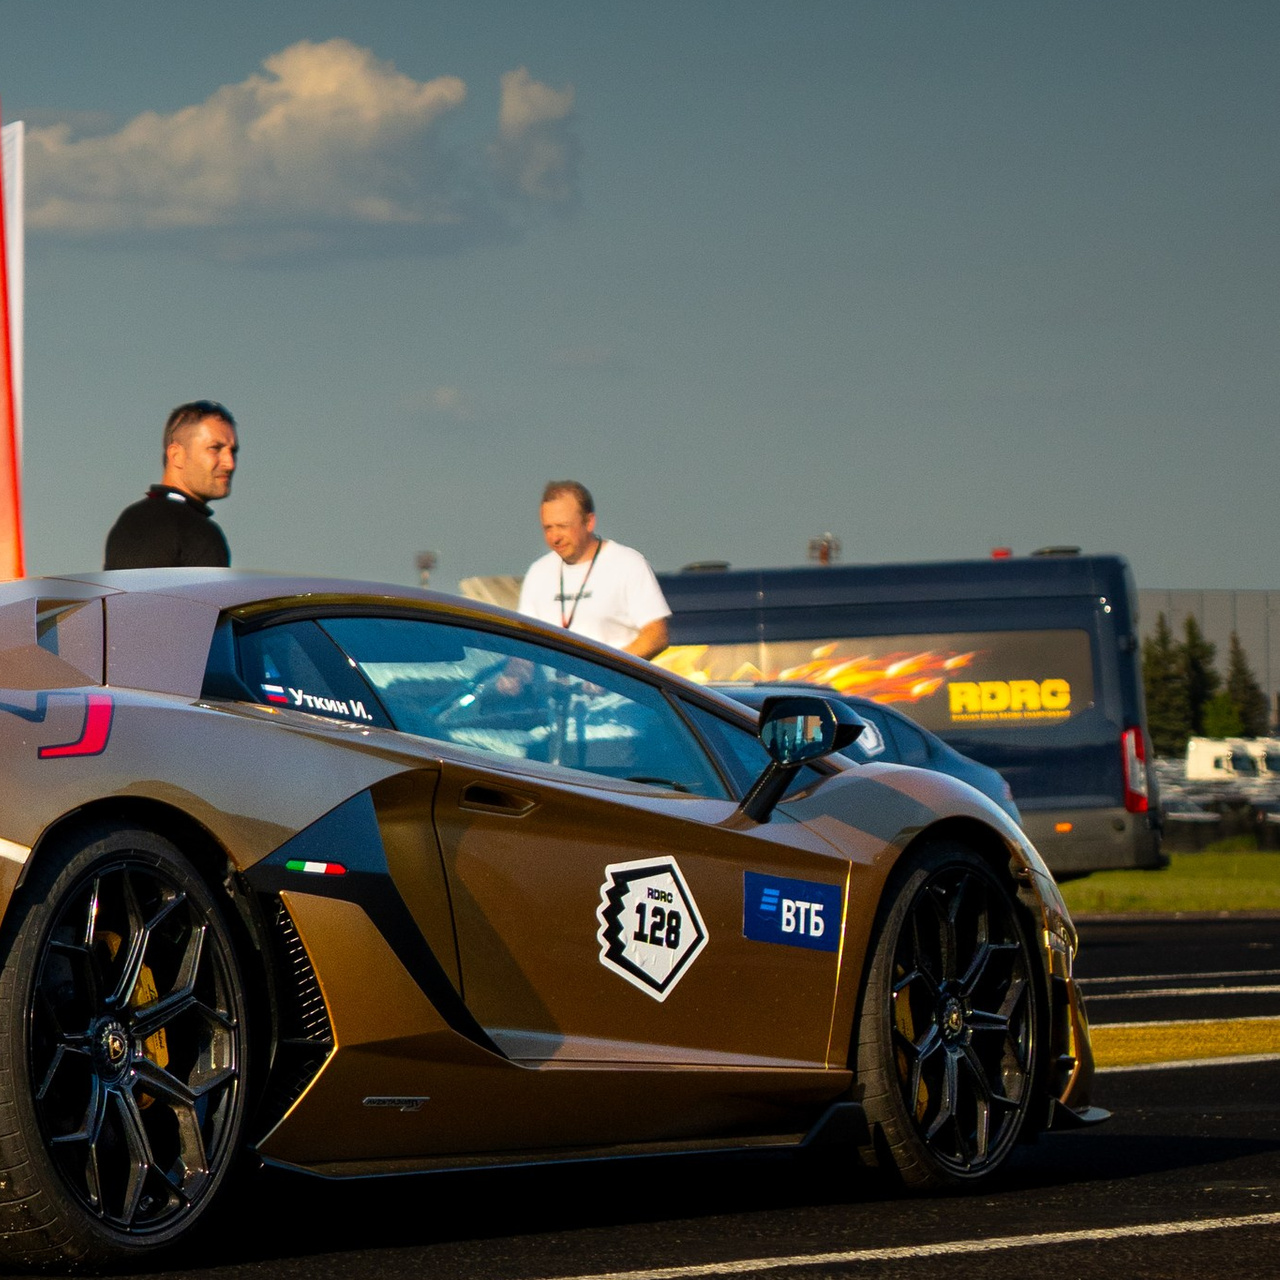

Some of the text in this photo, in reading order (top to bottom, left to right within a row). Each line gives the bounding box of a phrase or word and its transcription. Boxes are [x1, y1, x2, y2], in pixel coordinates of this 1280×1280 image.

[288, 687, 374, 721] Уткин И.
[948, 679, 1072, 713] RDRC
[646, 886, 674, 904] RDRC
[633, 901, 682, 950] 128
[781, 898, 826, 937] ВТБ
